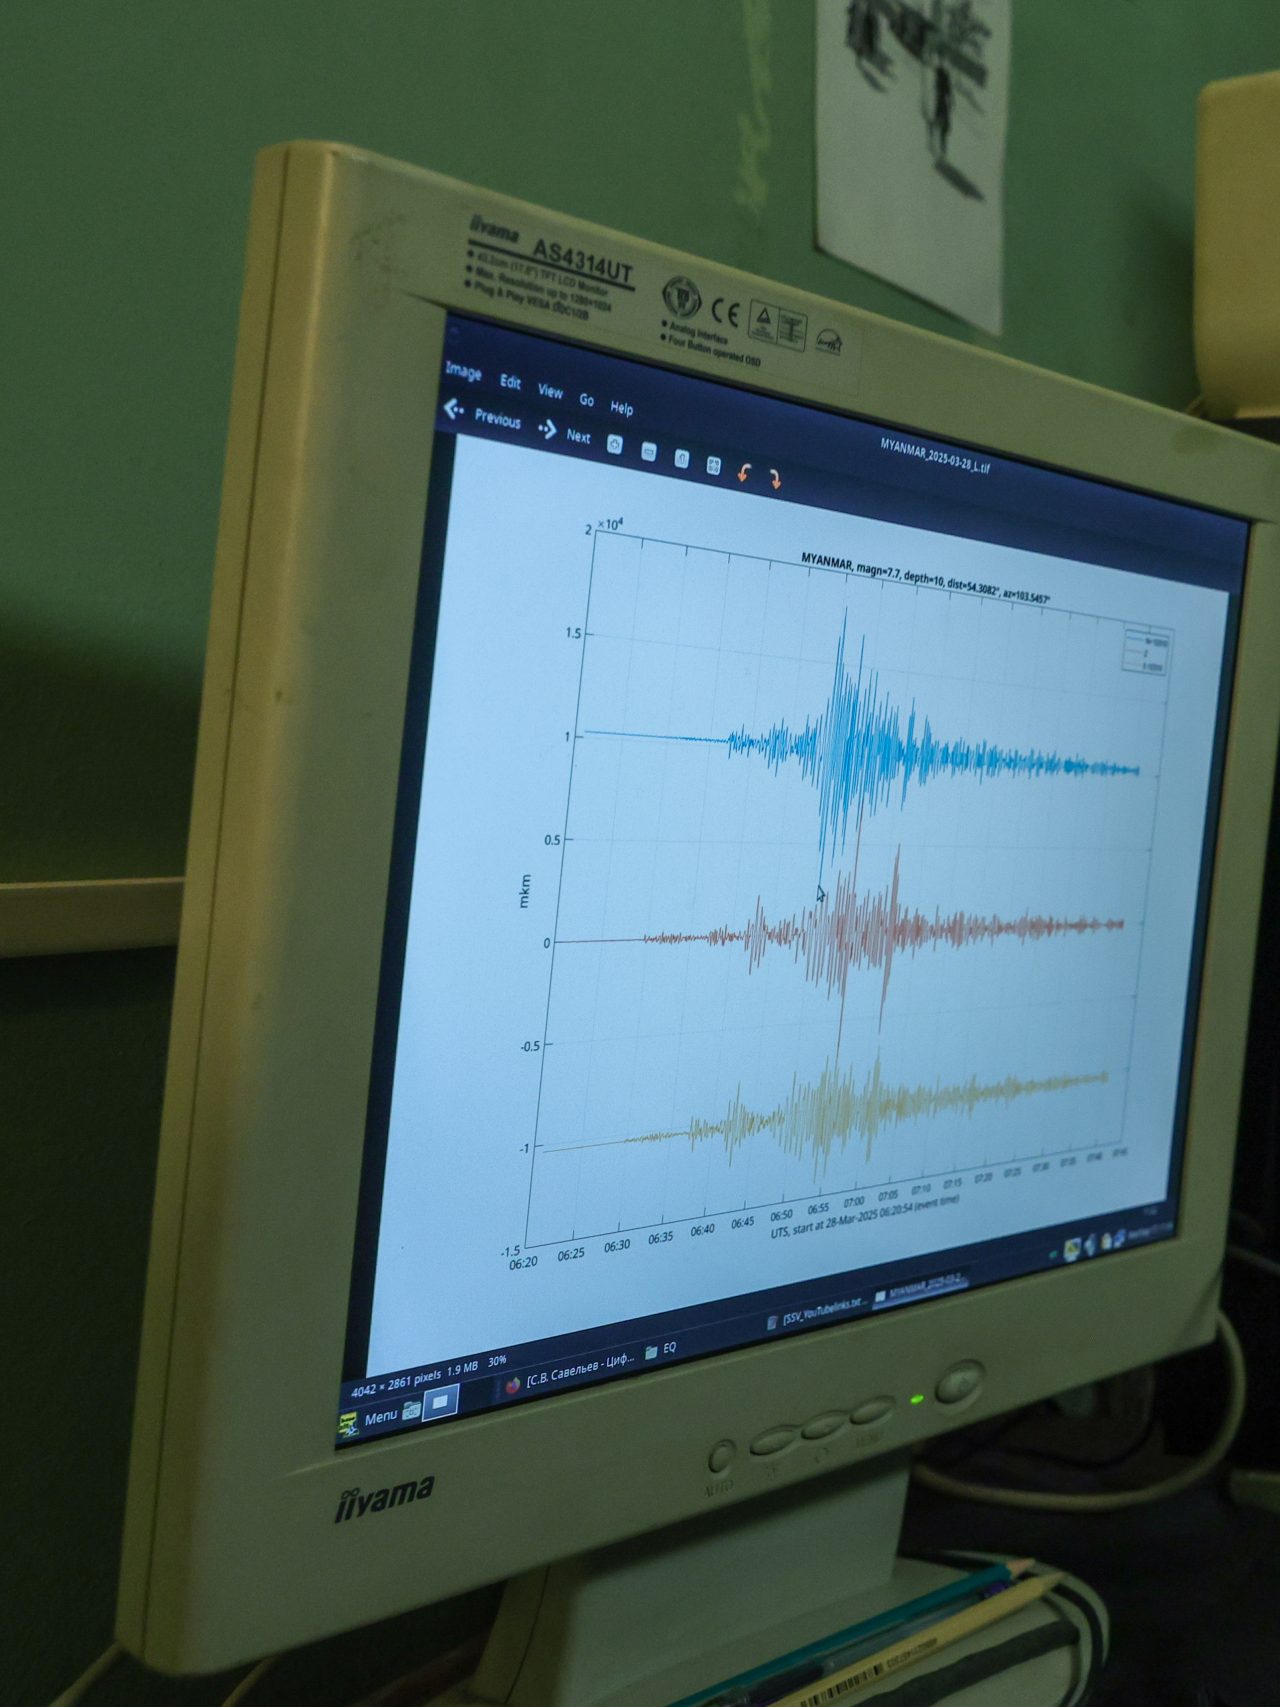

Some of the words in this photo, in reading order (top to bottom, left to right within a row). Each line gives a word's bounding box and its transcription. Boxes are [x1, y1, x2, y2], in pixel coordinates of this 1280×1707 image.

[533, 238, 633, 283] AS4314UT
[558, 274, 576, 288] LCD
[669, 320, 695, 338] Analog
[668, 334, 686, 349] Four
[687, 338, 711, 355] Button
[713, 346, 744, 363] operated
[745, 355, 761, 367] OSD
[445, 360, 482, 382] Image
[500, 373, 522, 391] Edit
[538, 382, 564, 400] View
[579, 392, 595, 407] Go
[610, 400, 634, 418] Help
[475, 408, 522, 430] Previous
[567, 427, 591, 445] Next
[585, 524, 593, 536] 2
[801, 552, 855, 572] MYANMAR,
[857, 563, 903, 581] magn=7.7,
[904, 570, 946, 588] depth=10,
[566, 626, 582, 640] 1.5
[544, 834, 561, 847] 0.5
[519, 873, 531, 909] mkm
[543, 937, 551, 949] 0
[520, 1040, 541, 1052] -0.5
[519, 1143, 529, 1154] -1
[509, 1256, 538, 1271] 06:20
[557, 1247, 585, 1262] 06:25
[604, 1238, 631, 1253] 06:30
[648, 1230, 674, 1245] 06:35
[690, 1223, 715, 1237] 06:40
[731, 1216, 755, 1230] 06:45
[770, 1208, 793, 1222] 06:50
[807, 1202, 830, 1215] 06:55
[843, 1196, 865, 1208] 07:00
[878, 1189, 899, 1202] 07:05
[771, 1225, 791, 1240] UTS,
[793, 1220, 814, 1235] start
[815, 1219, 824, 1231] at
[826, 1208, 878, 1229] 28-Mar-2025
[879, 1201, 913, 1218] 06:20:54
[500, 1245, 521, 1258] -1.5
[663, 1341, 677, 1355] EQ
[351, 1384, 376, 1399] 4042
[388, 1377, 411, 1392] 2861
[414, 1369, 442, 1388] pixels
[447, 1364, 461, 1377] 1.9
[463, 1360, 479, 1374] MB
[488, 1354, 507, 1368] 30%
[551, 1361, 599, 1382] Савельев
[365, 1407, 398, 1427] Menu
[334, 1474, 436, 1525] iiyama
